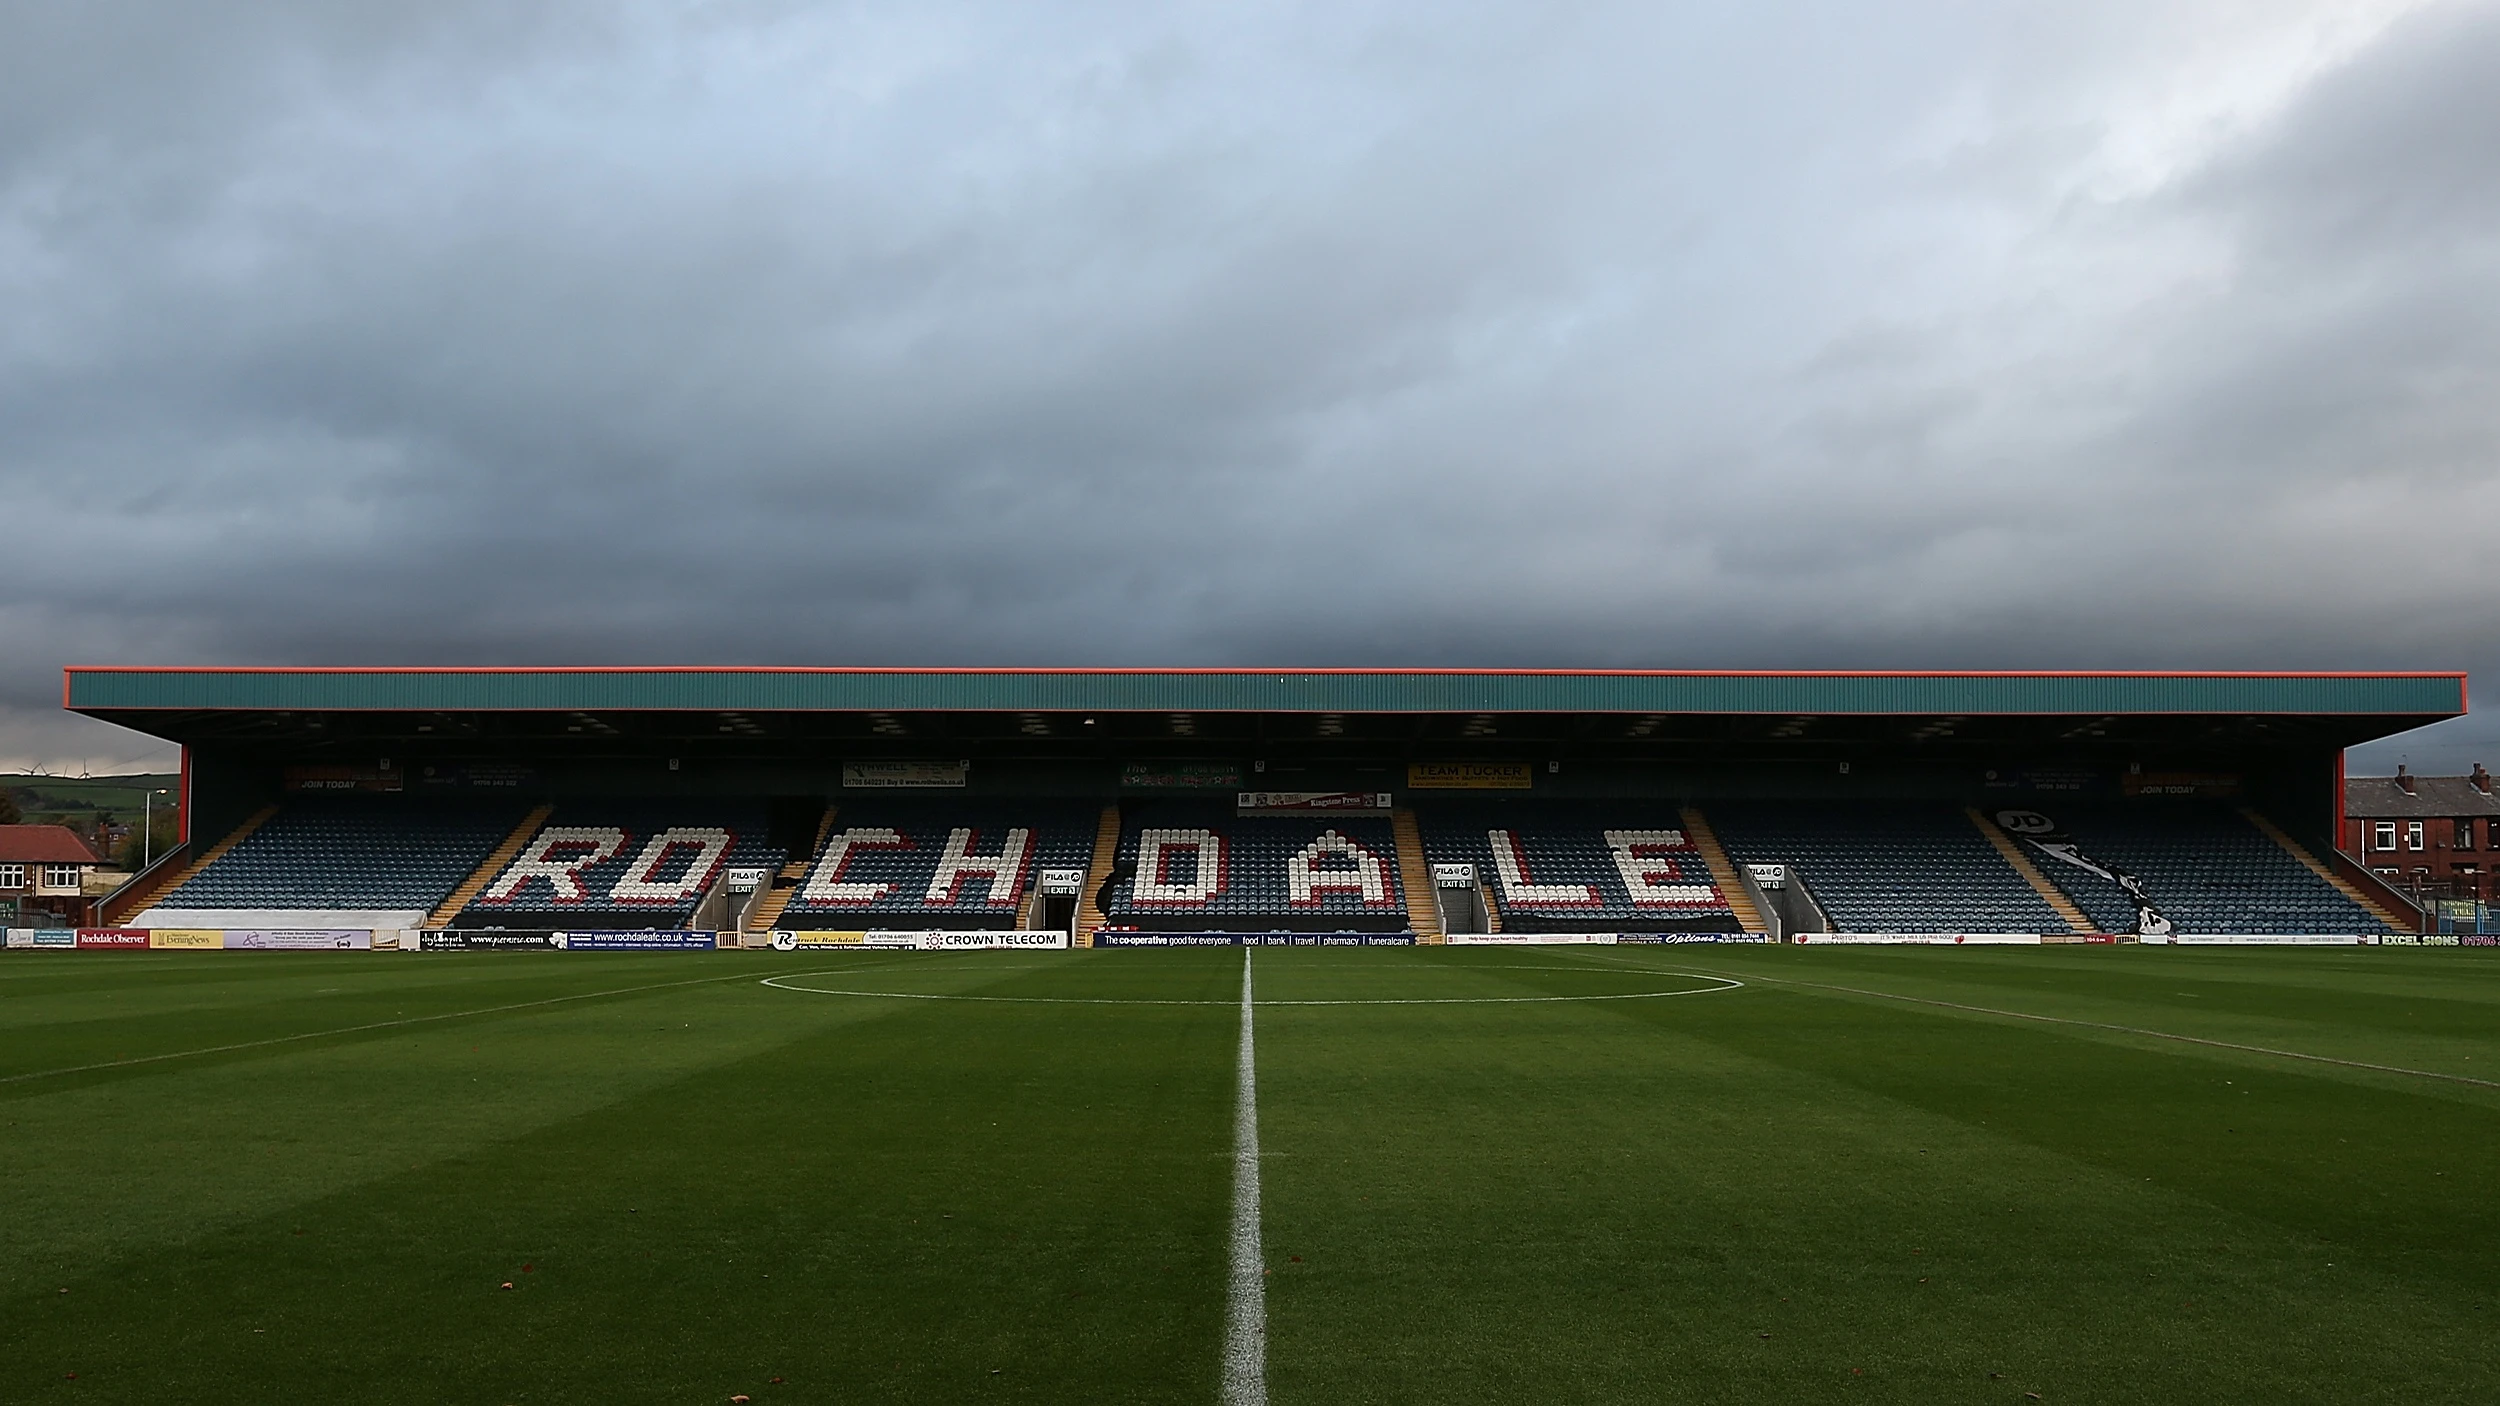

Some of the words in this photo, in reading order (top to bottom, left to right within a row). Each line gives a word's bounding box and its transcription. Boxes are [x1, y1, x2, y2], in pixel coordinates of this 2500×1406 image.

[1418, 765, 1459, 776] TEAM
[1462, 765, 1523, 776] TUCKER
[301, 780, 323, 789] JOIN
[325, 780, 356, 789] TODAY
[2141, 786, 2163, 795] JOIN
[2164, 786, 2196, 795] TODAY
[1342, 797, 1361, 805] Press
[2010, 815, 2046, 829] JD
[1436, 867, 1453, 875] FILA
[1045, 873, 1063, 881] FILA
[1442, 880, 1458, 888] EXIT
[1051, 886, 1069, 894] EXIT
[81, 932, 113, 944] Rochdale
[113, 932, 145, 944] Observer
[594, 932, 683, 942] www.rochdaleafc.co.uk
[946, 935, 993, 945] CROWN
[998, 935, 1057, 944] TELECOM
[1105, 935, 1119, 945] The
[1119, 935, 1168, 946] co-operative
[1169, 936, 1188, 947] good
[1188, 936, 1198, 945] for
[1199, 937, 1231, 947] everyone
[1243, 936, 1259, 945] food
[1267, 936, 1286, 945] bank
[1295, 936, 1315, 945] travel
[1323, 937, 1359, 947] pharmacy
[1368, 936, 1409, 946] funeralcare
[1665, 933, 1716, 944] Options
[2381, 935, 2422, 946] EXCEL
[2462, 935, 2496, 947] 01706
